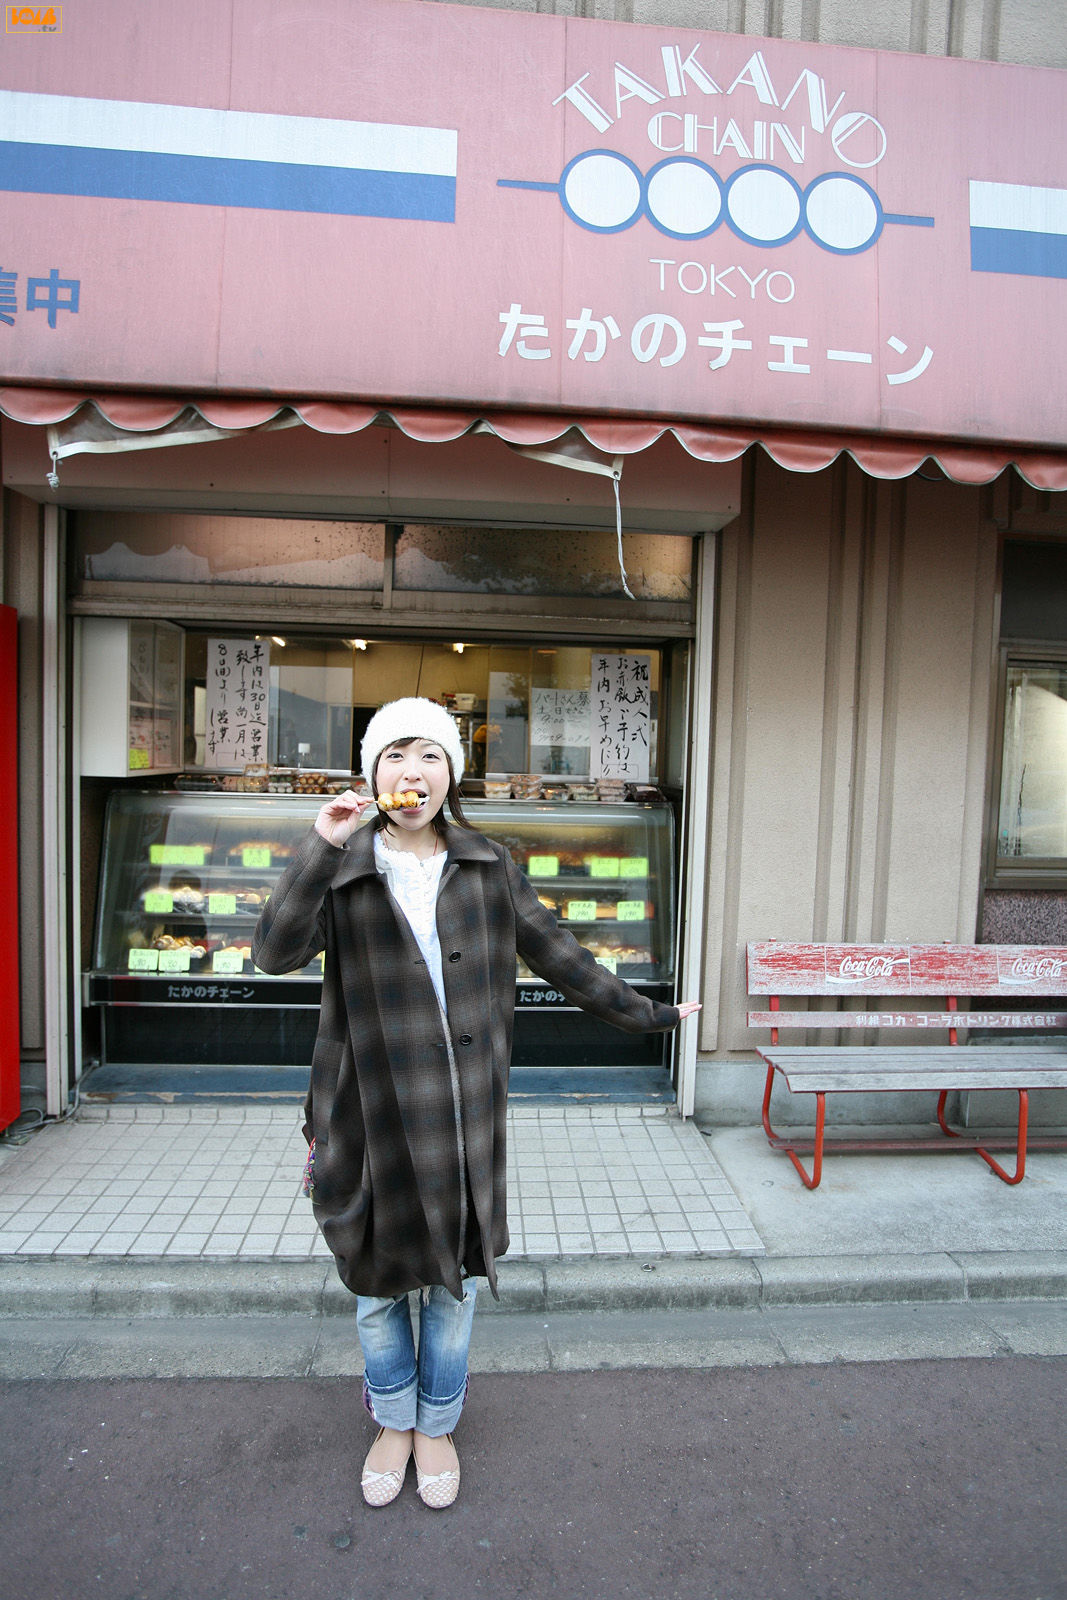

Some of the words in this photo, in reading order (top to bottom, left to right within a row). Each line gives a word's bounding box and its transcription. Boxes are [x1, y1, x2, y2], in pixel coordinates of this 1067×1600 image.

[552, 43, 887, 168] TAKANO
[647, 111, 805, 164] CHAIN
[649, 258, 795, 303] TOKYO
[497, 303, 934, 385] たかのチェーン
[631, 660, 649, 747] 祝成人式
[839, 955, 894, 977] Coca-Cola
[1011, 957, 1063, 978] Coca-Cola
[167, 984, 255, 998] たかのチェーン
